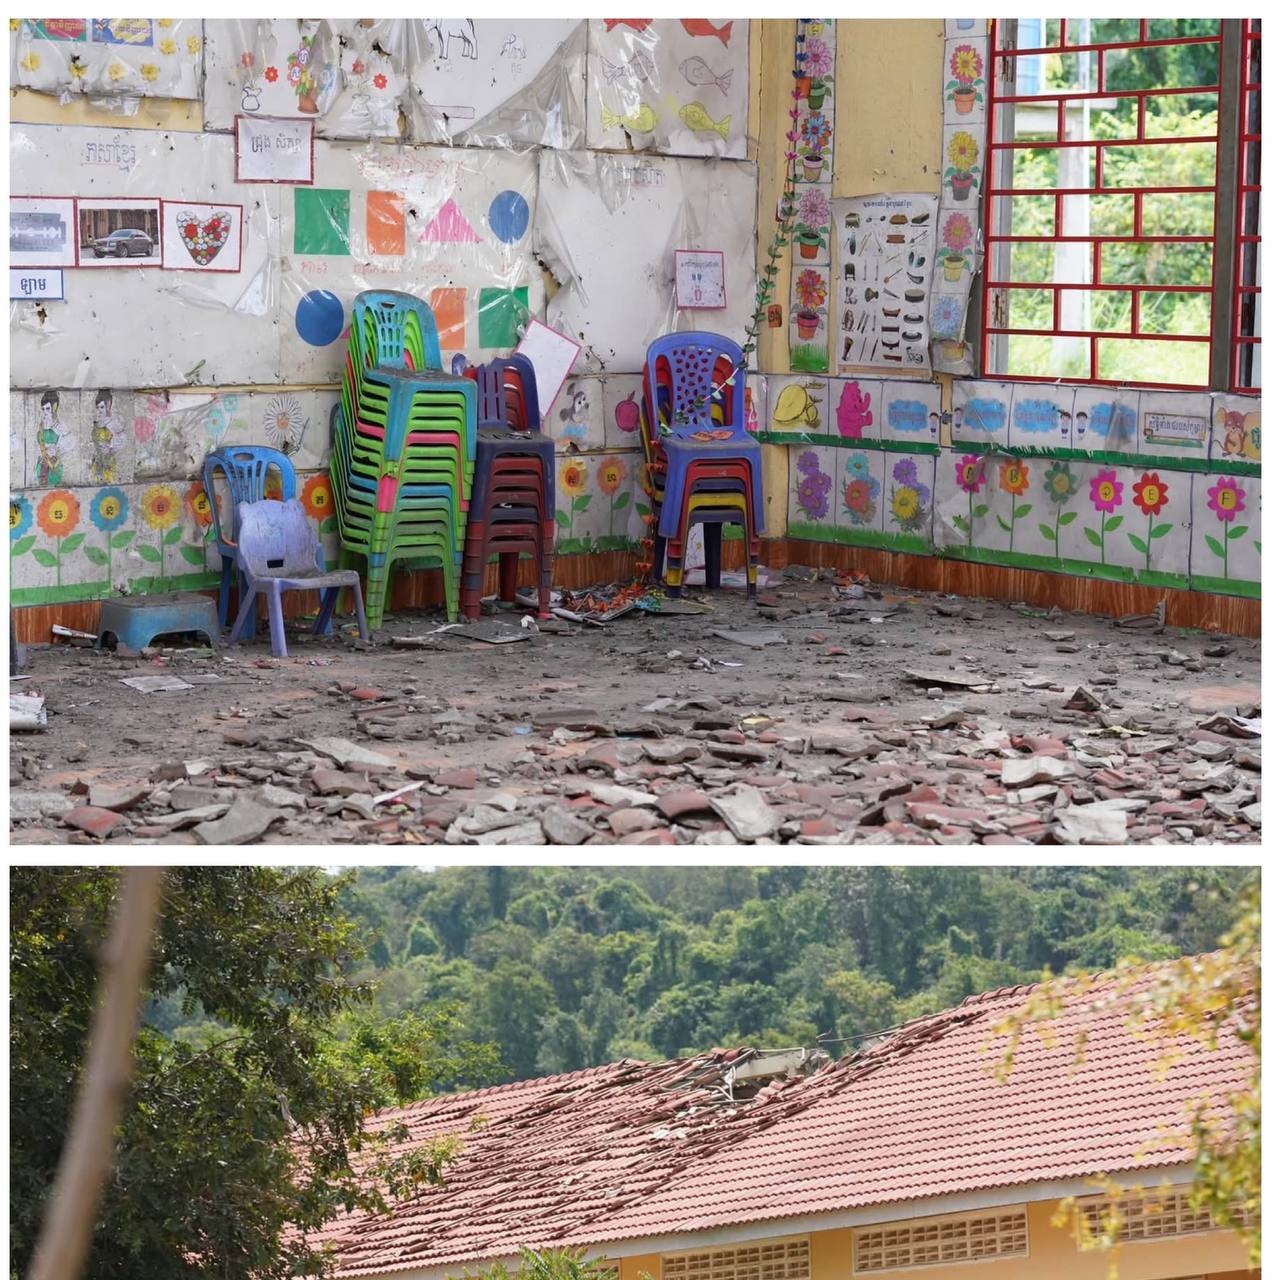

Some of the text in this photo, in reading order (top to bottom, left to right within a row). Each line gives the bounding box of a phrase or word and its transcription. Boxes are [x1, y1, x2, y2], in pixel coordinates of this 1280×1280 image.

[20, 278, 47, 295] ឡាម
[1148, 488, 1156, 501] E
[1221, 491, 1231, 505] F
